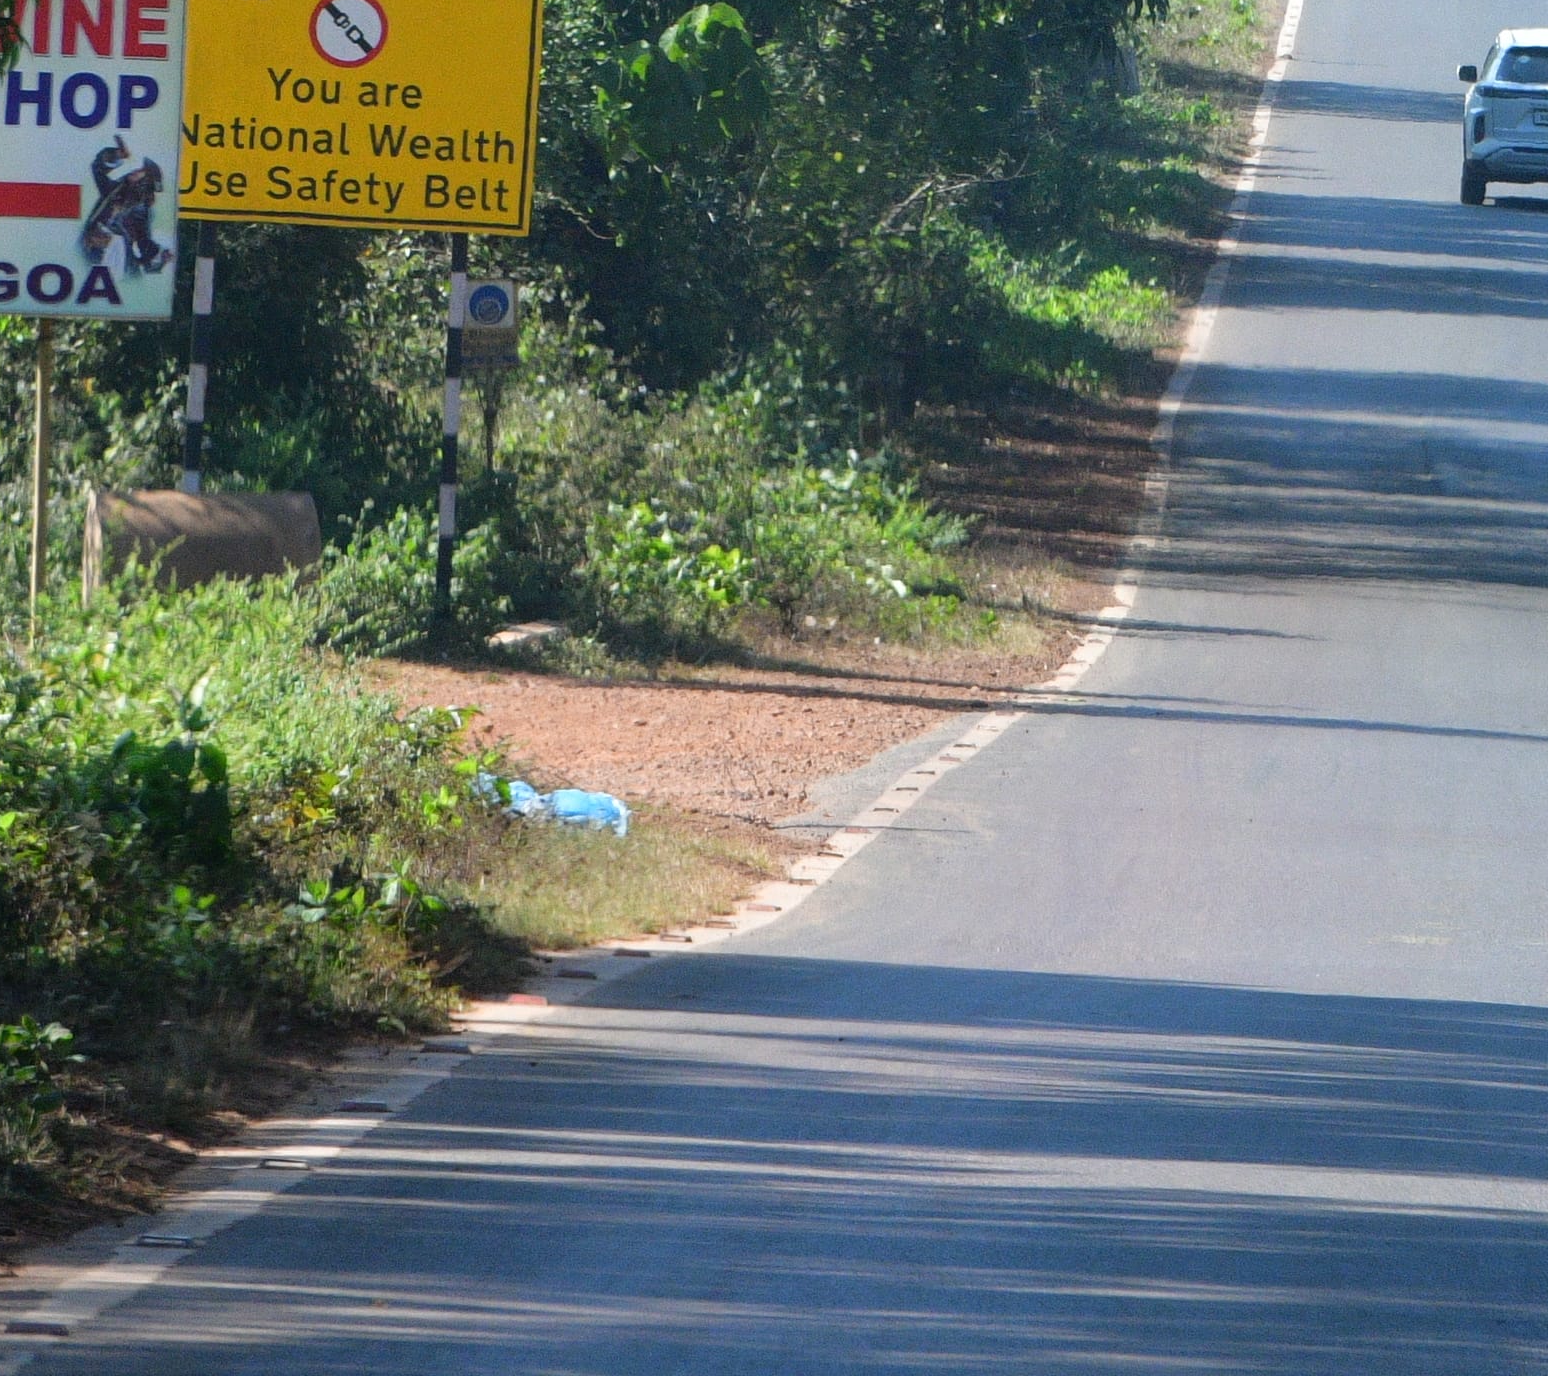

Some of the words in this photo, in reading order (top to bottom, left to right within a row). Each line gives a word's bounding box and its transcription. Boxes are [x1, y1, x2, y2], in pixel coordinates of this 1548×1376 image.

[267, 67, 341, 105] You
[358, 81, 423, 109] are
[182, 113, 350, 155] National
[369, 123, 515, 164] Wealth
[266, 165, 405, 213] Safety
[424, 174, 509, 212] Belt
